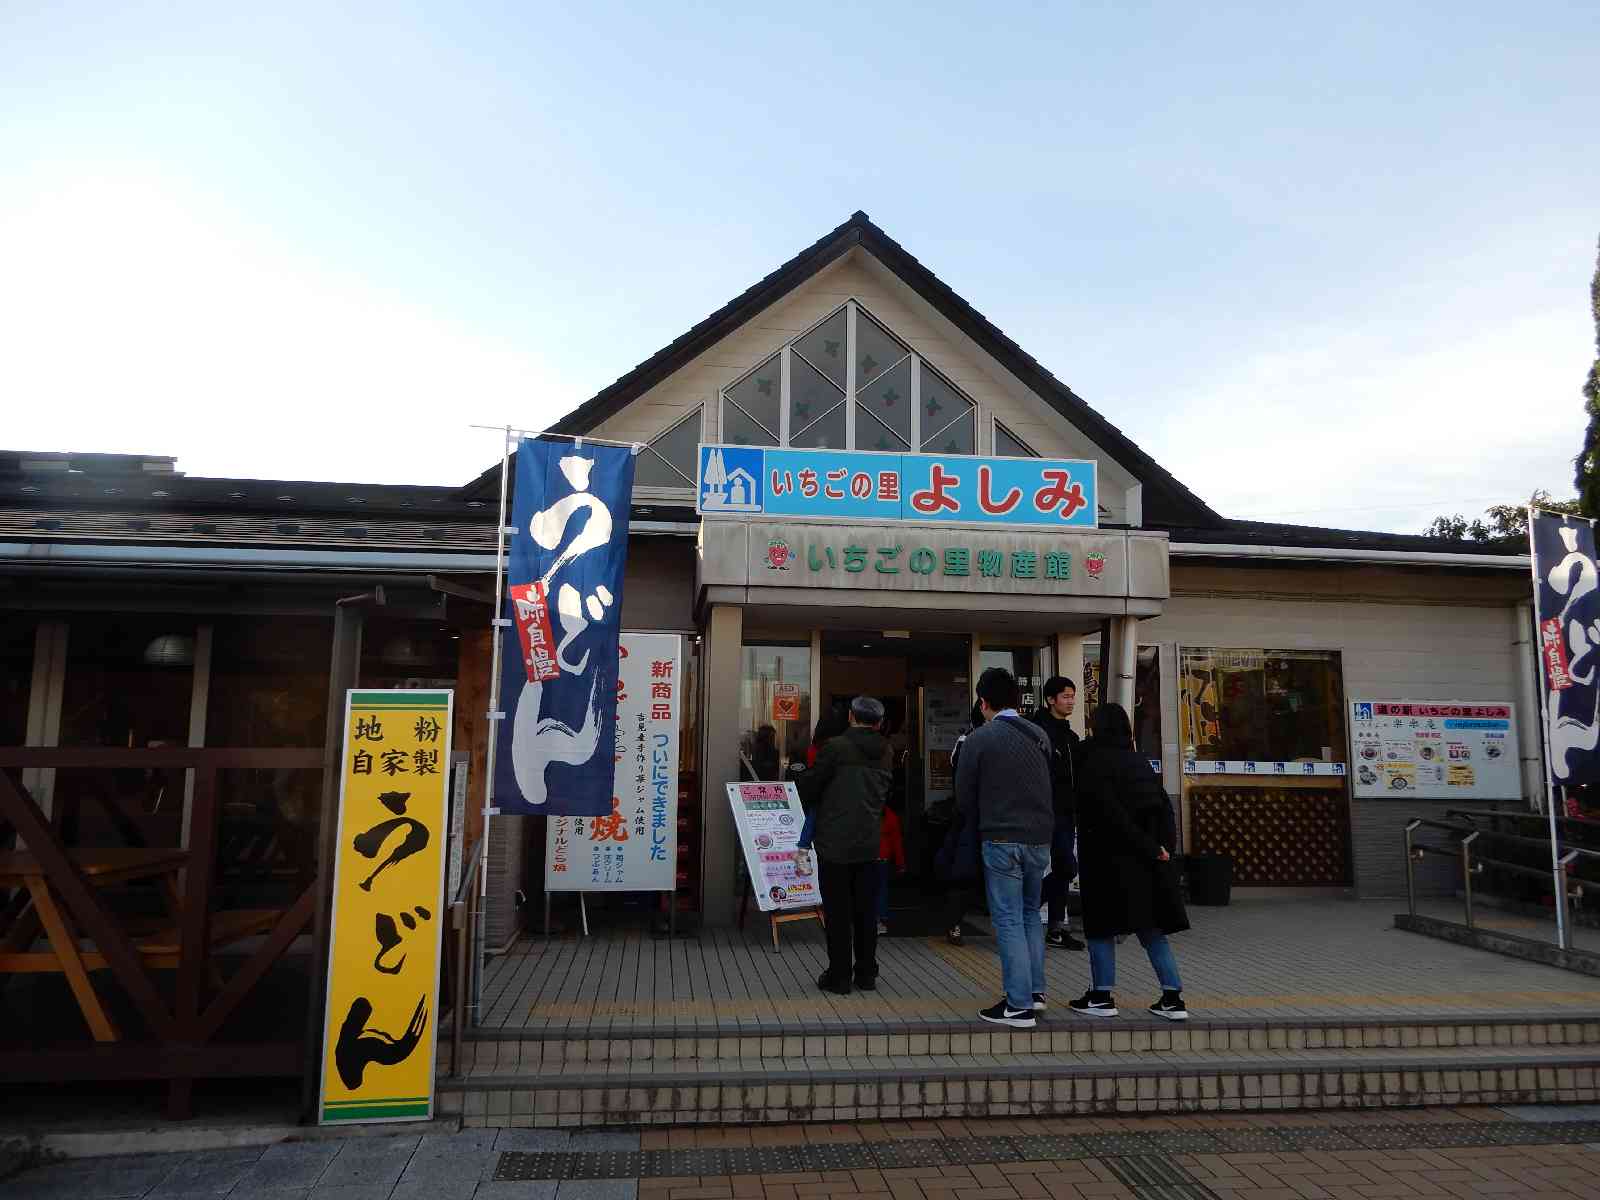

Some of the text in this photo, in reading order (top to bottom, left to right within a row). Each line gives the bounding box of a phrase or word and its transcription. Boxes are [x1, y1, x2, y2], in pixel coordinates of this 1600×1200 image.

[772, 464, 1088, 519] いちごの里 よしみ
[807, 543, 1073, 581] いちごの里物産館
[510, 455, 614, 804] うどん
[354, 716, 441, 743] 地粉
[352, 750, 440, 776] 自家製
[649, 660, 673, 861] 新商品 ついにできました
[335, 790, 431, 1090] うどん
